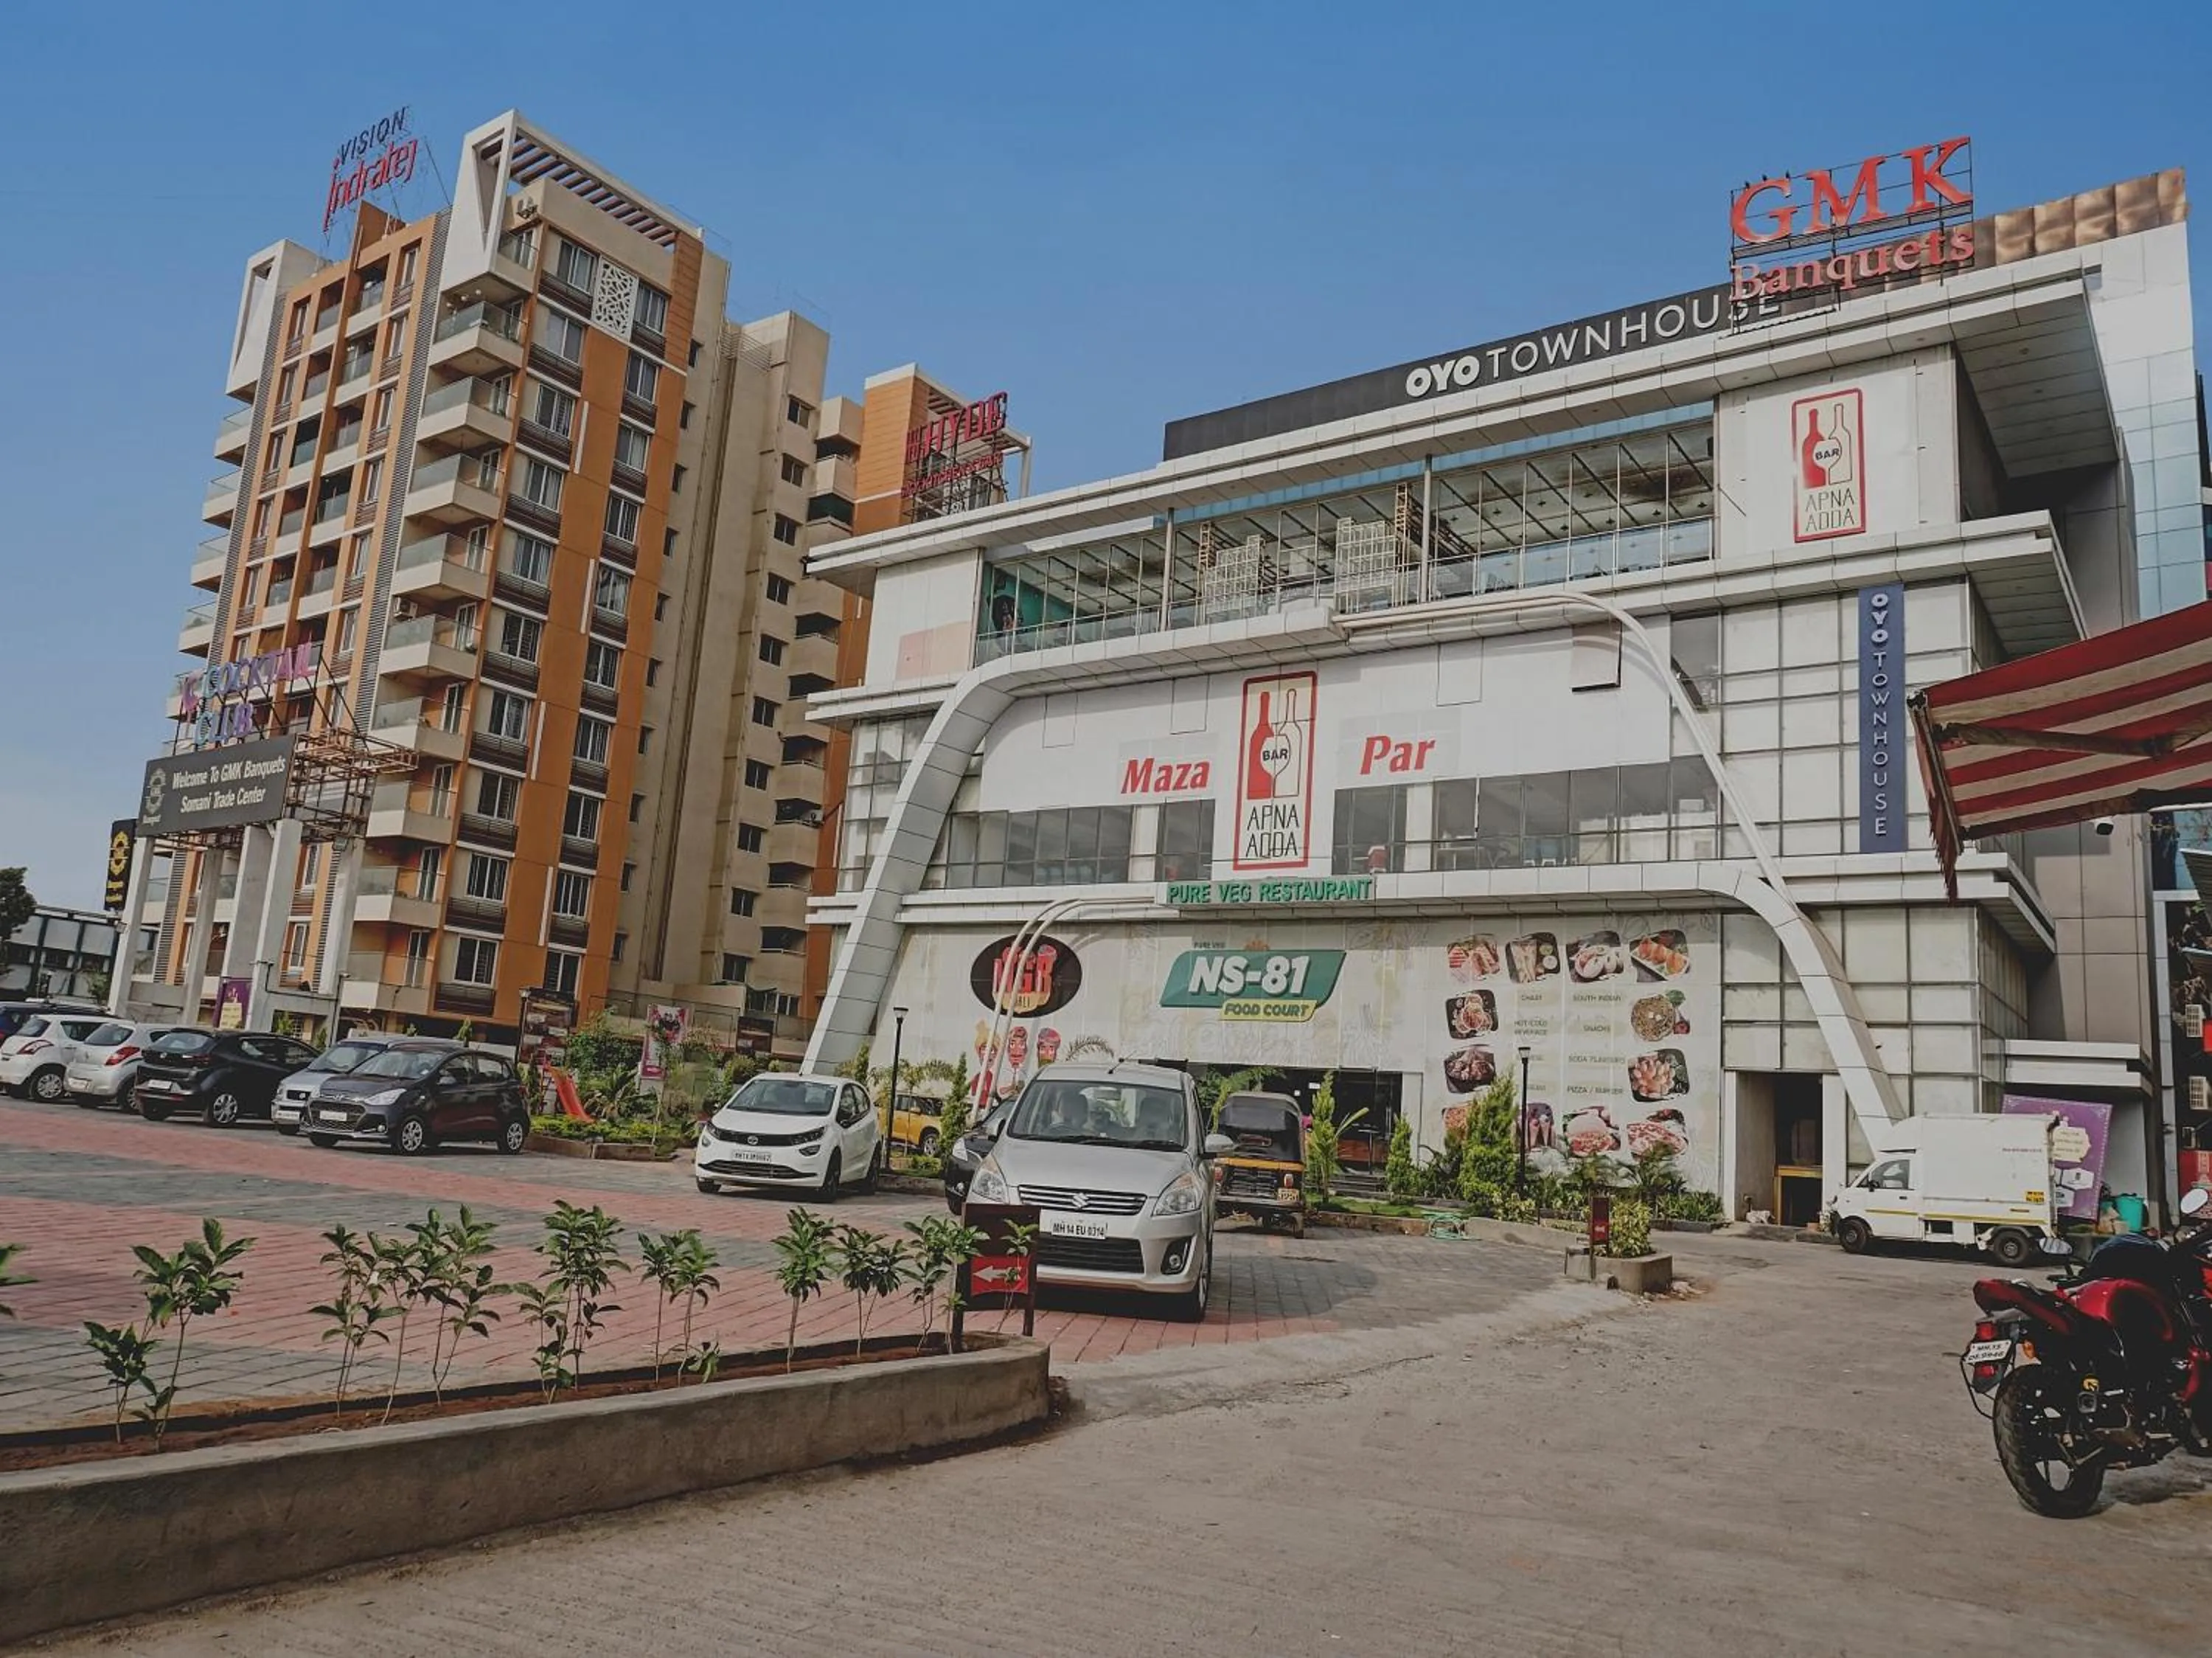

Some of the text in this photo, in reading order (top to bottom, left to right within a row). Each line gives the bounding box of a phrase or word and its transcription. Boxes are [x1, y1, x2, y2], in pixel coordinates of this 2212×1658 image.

[340, 105, 409, 165] VISION
[1730, 136, 1974, 244] GMK
[1730, 229, 1975, 303] Banquets
[1405, 355, 1481, 398] OYO
[1815, 447, 1841, 462] BAR
[1805, 487, 1855, 513] APNA
[1805, 507, 1855, 533] ADDA
[1871, 592, 1891, 835] OYO TOWNHOUSE
[1261, 747, 1290, 763] BAR
[1358, 735, 1437, 775] Par
[172, 755, 287, 791] Welcome To GMK Banquets
[1120, 757, 1211, 794] Maza
[179, 791, 211, 814] Somani
[212, 788, 235, 810] Trade
[236, 785, 267, 805] Center
[1245, 804, 1301, 832] APNA
[1245, 831, 1299, 859] ADDA
[1166, 878, 1373, 904] PURE VEG RESTAURANT
[1187, 955, 1310, 996] NS-81
[1223, 1002, 1310, 1017] FOOD COURT
[1567, 1085, 1587, 1093] PIZZA
